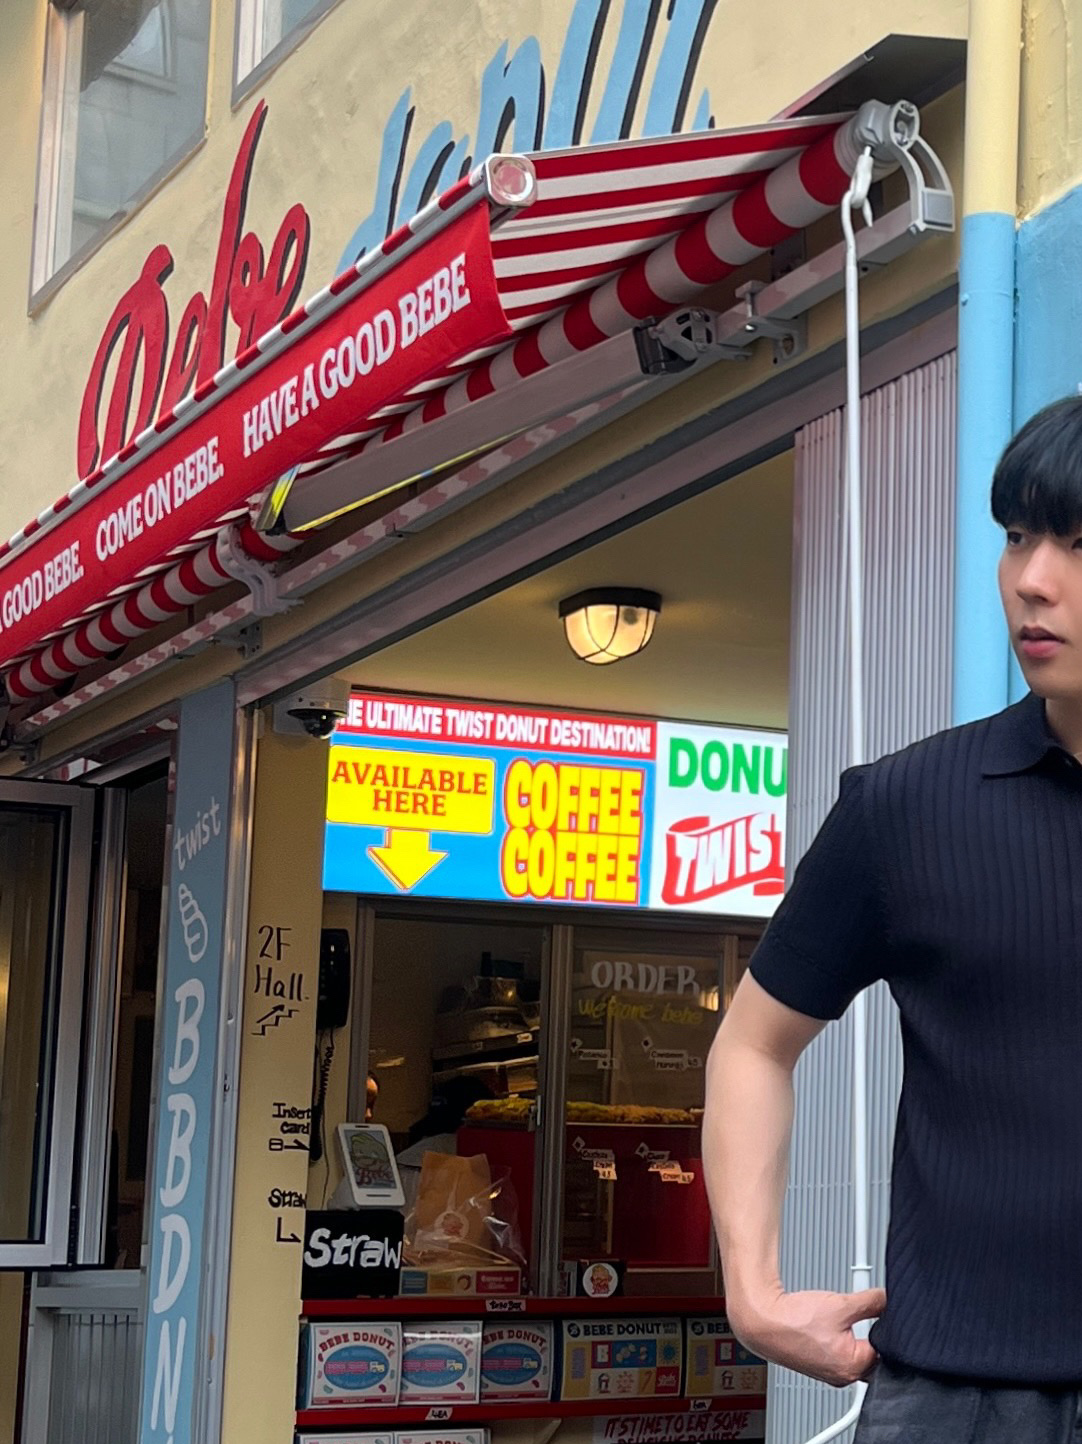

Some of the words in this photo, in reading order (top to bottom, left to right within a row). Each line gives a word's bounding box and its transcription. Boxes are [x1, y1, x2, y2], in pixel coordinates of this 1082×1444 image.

[3, 570, 43, 629] GOOD
[44, 540, 84, 602] BEBE.
[96, 493, 144, 561] COME
[144, 471, 172, 527] ON
[173, 436, 225, 508] BEBE.
[243, 376, 299, 458] HAVE
[301, 363, 320, 417] A
[319, 310, 397, 399] GOOD
[399, 252, 471, 349] BEBE
[366, 700, 443, 735] ULTIMATE
[445, 708, 494, 740] TWIST
[495, 712, 549, 745] DONUT
[550, 718, 651, 753] DESTINATION!
[332, 761, 488, 796] AVAILABLE
[505, 758, 643, 835] COFFEE
[372, 788, 447, 817] HERE
[174, 797, 221, 871] twist
[501, 826, 640, 903] COFFEE
[258, 924, 292, 960] 2F
[591, 960, 700, 996] ORDER
[303, 1228, 402, 1269] Straw
[319, 1332, 350, 1353] BEBE
[353, 1331, 395, 1349] DONUT
[508, 1329, 547, 1347] DONUT
[583, 1323, 613, 1336] BEBE
[617, 1322, 662, 1335] DONUT
[707, 1322, 731, 1334] BEB
